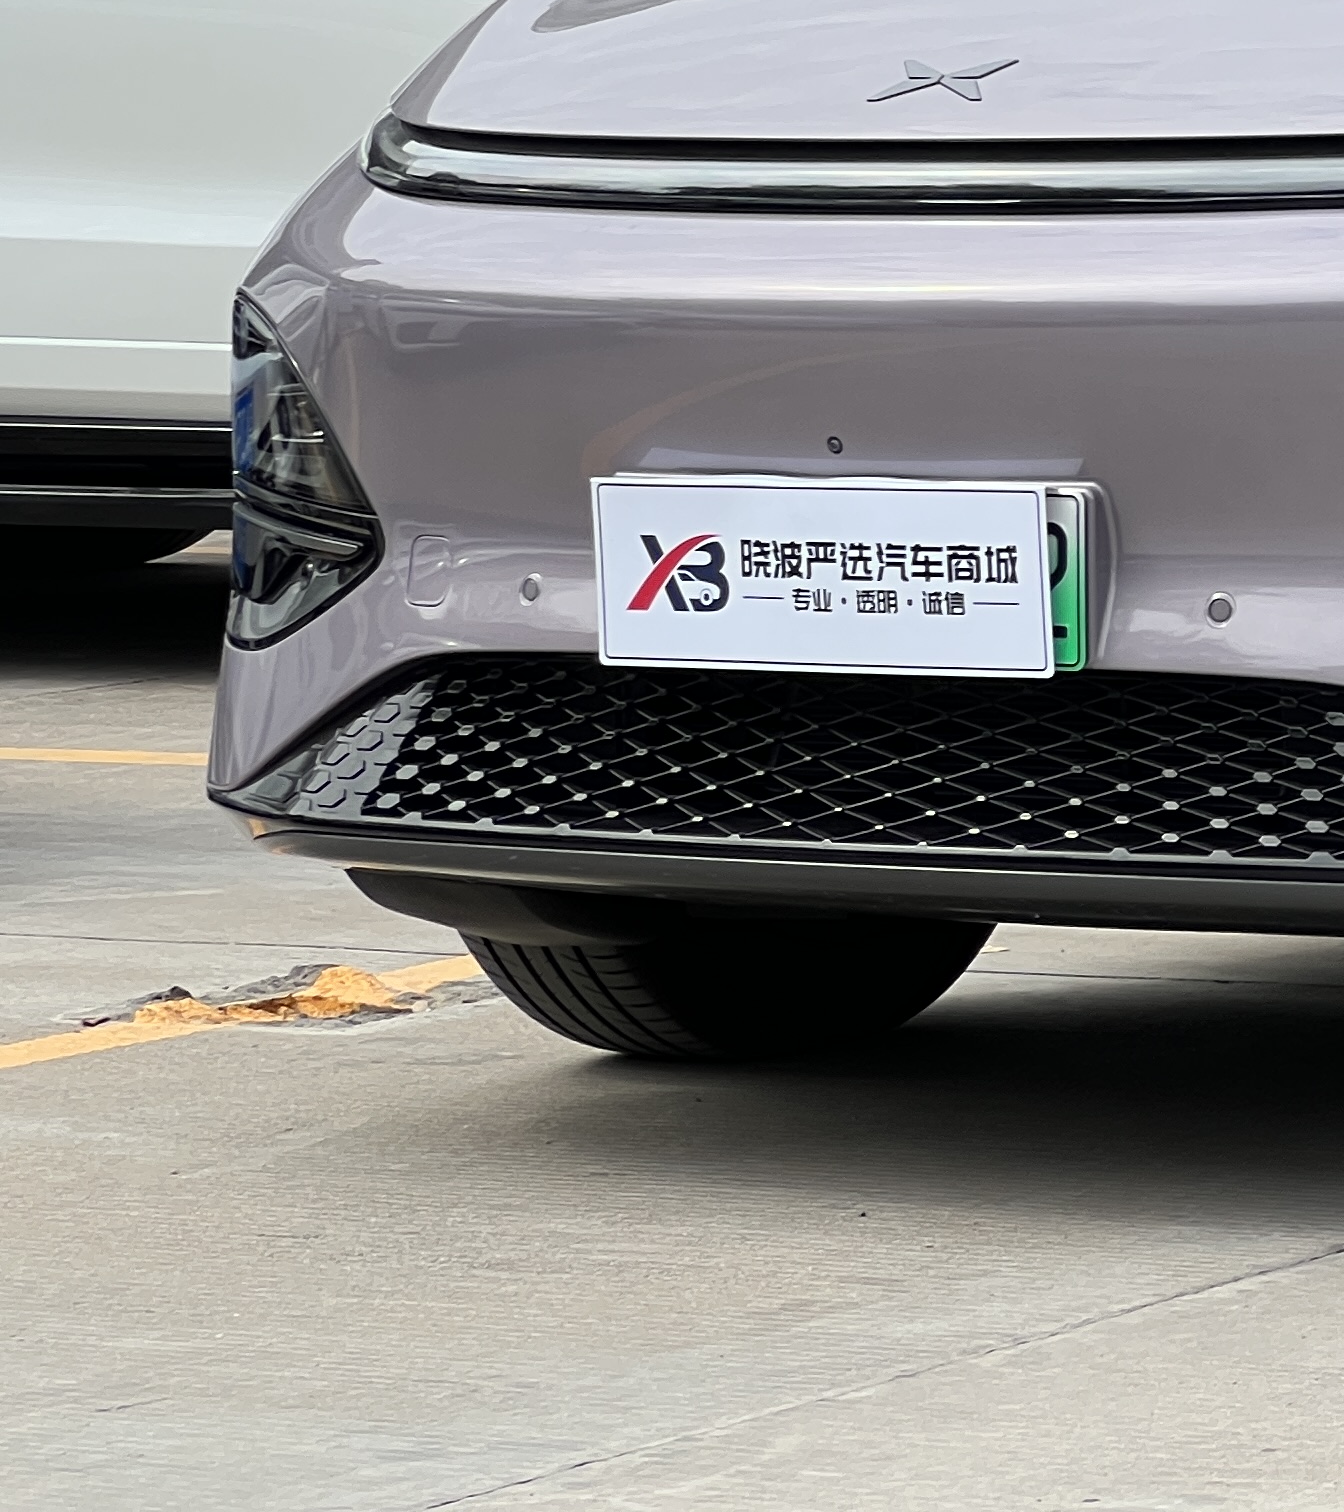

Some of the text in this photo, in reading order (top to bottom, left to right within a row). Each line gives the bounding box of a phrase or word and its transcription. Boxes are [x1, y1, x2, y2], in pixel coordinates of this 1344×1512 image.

[740, 539, 1019, 584] 晓波严选汽车商城
